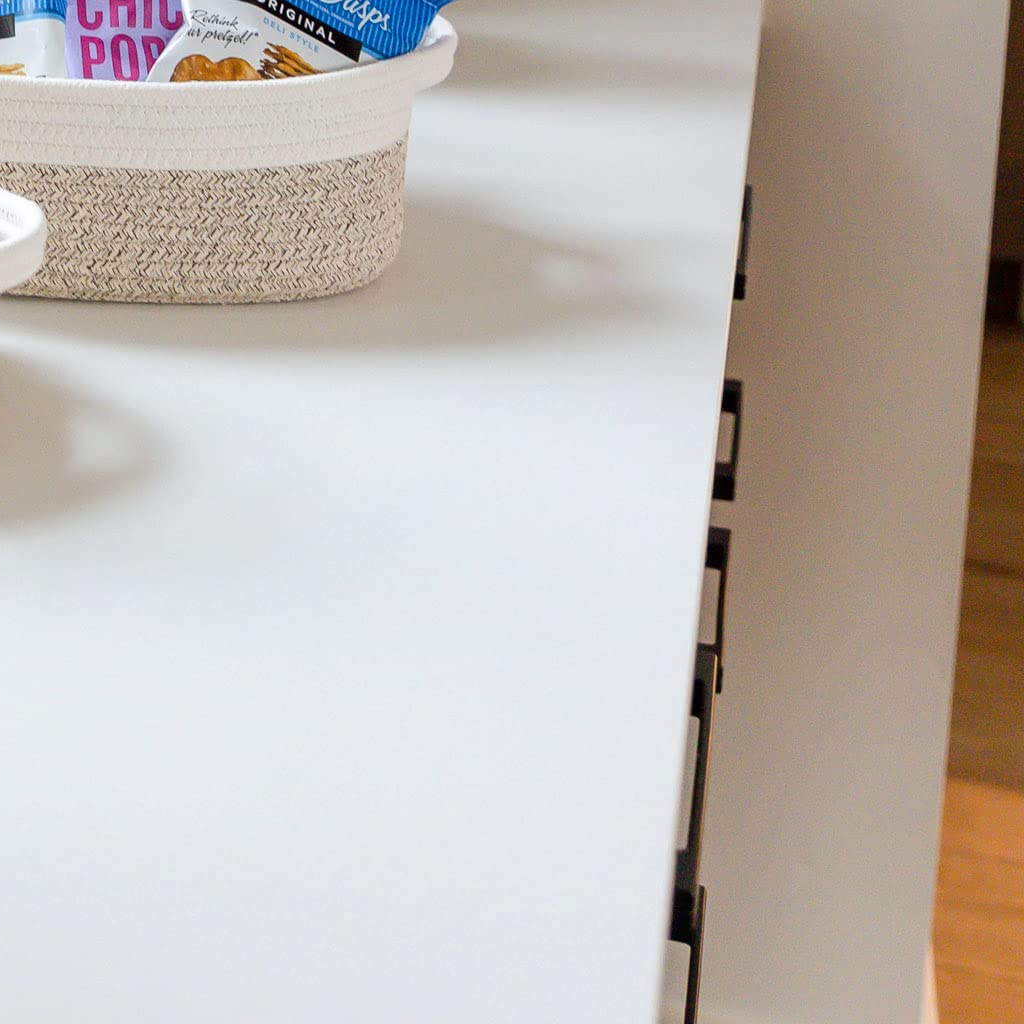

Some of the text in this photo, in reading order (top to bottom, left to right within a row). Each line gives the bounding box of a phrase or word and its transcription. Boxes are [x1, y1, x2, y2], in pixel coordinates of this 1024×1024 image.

[190, 9, 238, 31] Rethink
[263, 16, 320, 53] DELI STYLE
